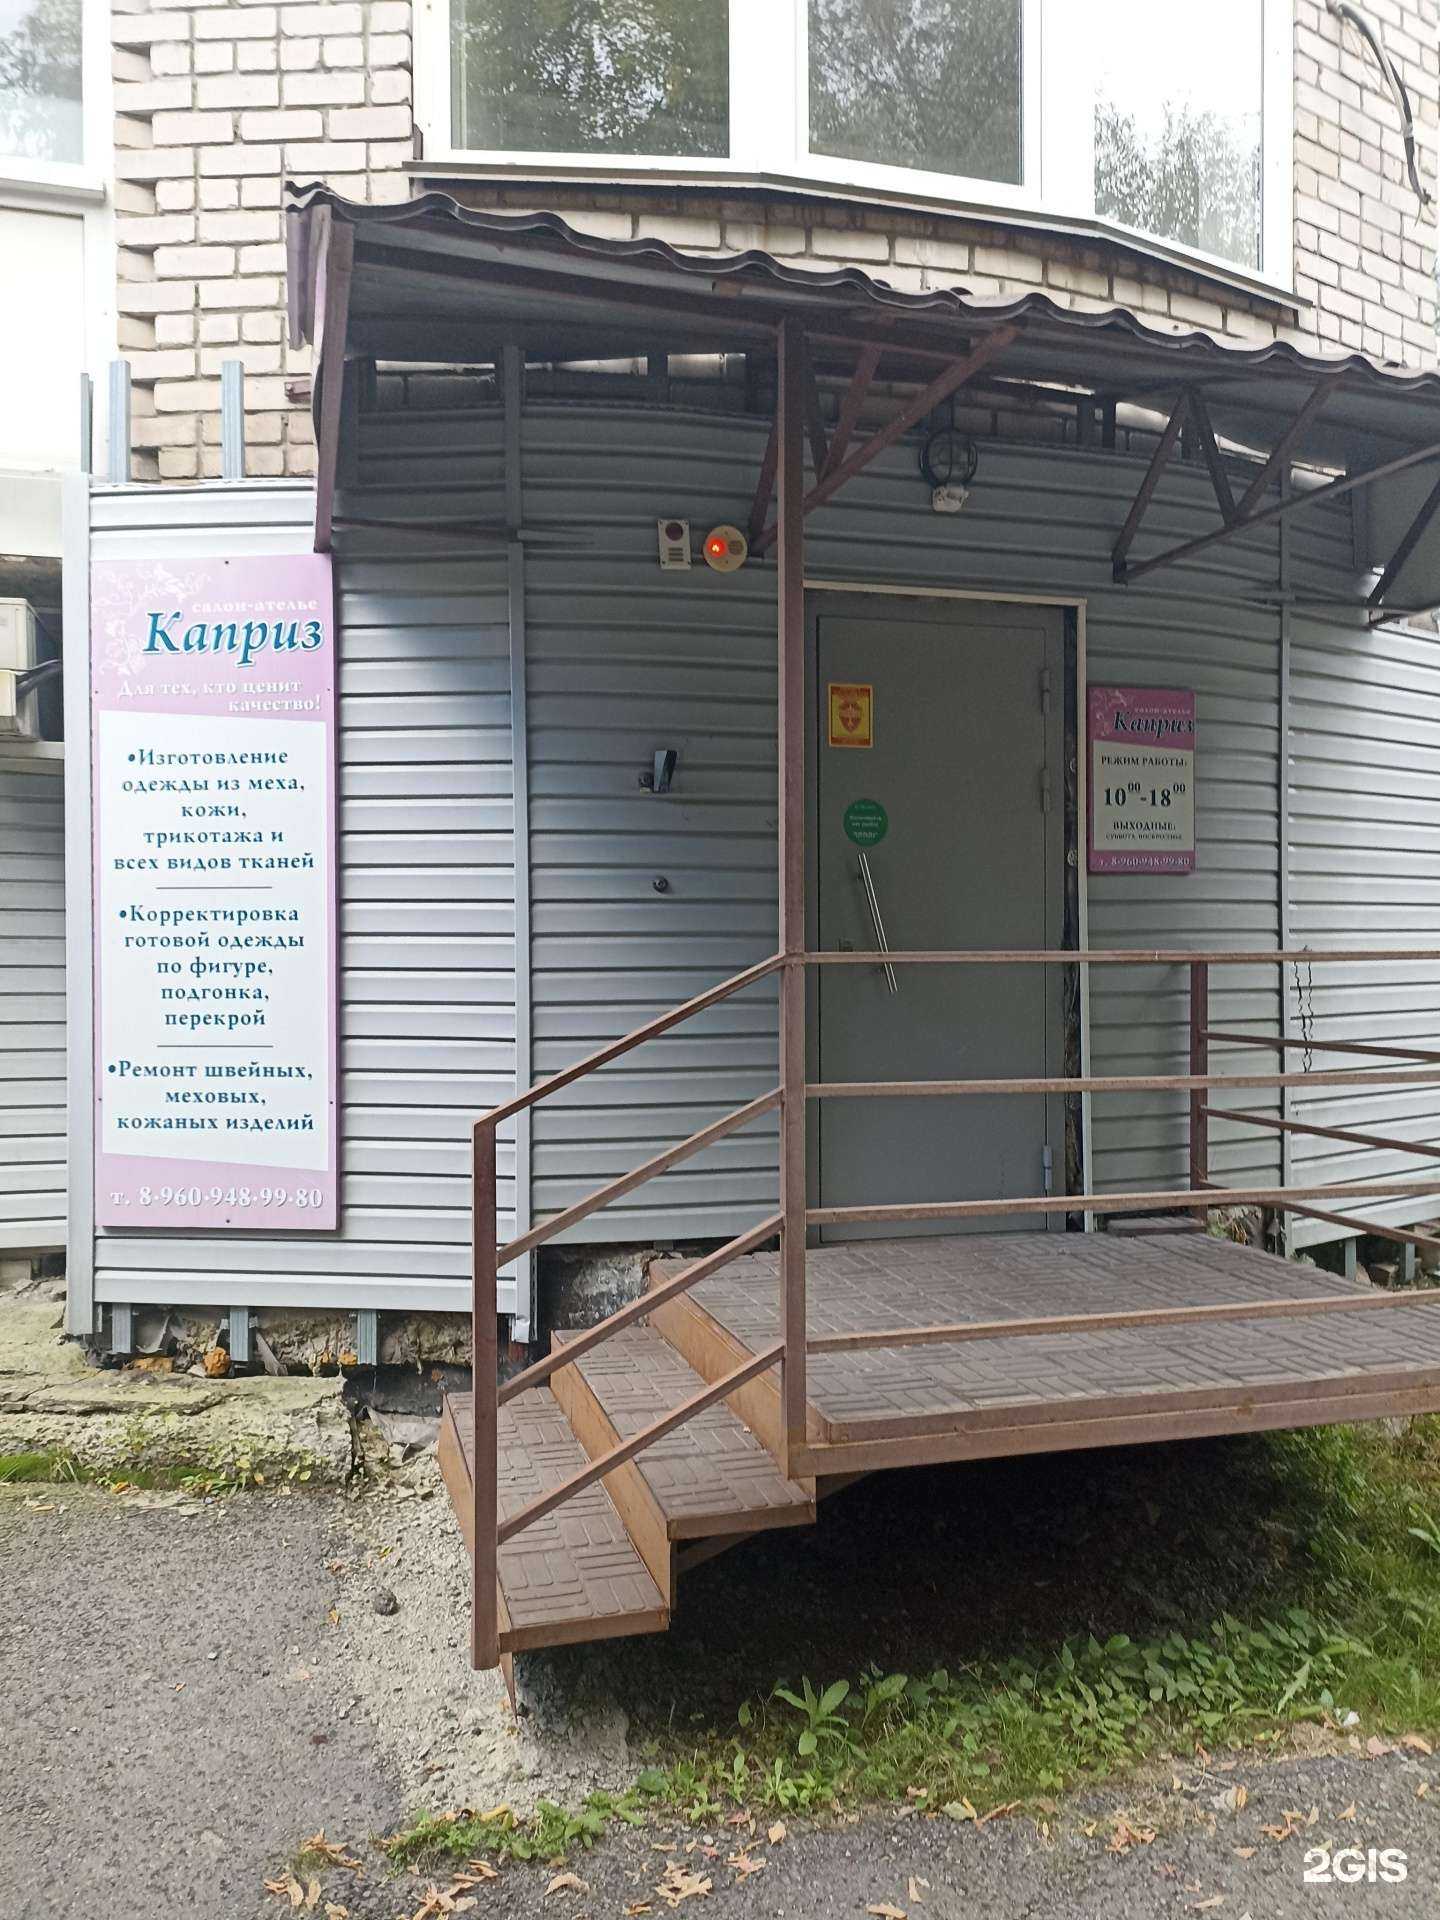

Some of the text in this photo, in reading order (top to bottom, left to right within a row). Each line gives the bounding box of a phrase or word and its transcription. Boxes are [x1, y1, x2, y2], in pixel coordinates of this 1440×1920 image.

[191, 600, 319, 614] салон-ателье
[142, 610, 323, 667] Каприз
[119, 680, 303, 697] Для тех, кто ценит
[229, 695, 321, 712] качество!
[1113, 711, 1196, 739] Каприз
[1101, 756, 1140, 766] РЕЖИМ
[122, 777, 305, 793] одежды из меха,
[181, 805, 248, 818] кожи,
[144, 831, 283, 848] трикотажа и
[114, 852, 314, 871] всех видов тканей
[125, 931, 305, 950] готовой одежды
[157, 956, 273, 978] по фигуре,
[161, 987, 269, 1001] подгонка,
[164, 1009, 266, 1030] перекрой
[204, 1061, 313, 1080] швейных,
[165, 1090, 266, 1106] меховых,
[117, 1114, 314, 1132] кожаных изделий
[110, 1186, 324, 1209] т. 8-960-948-99-80
